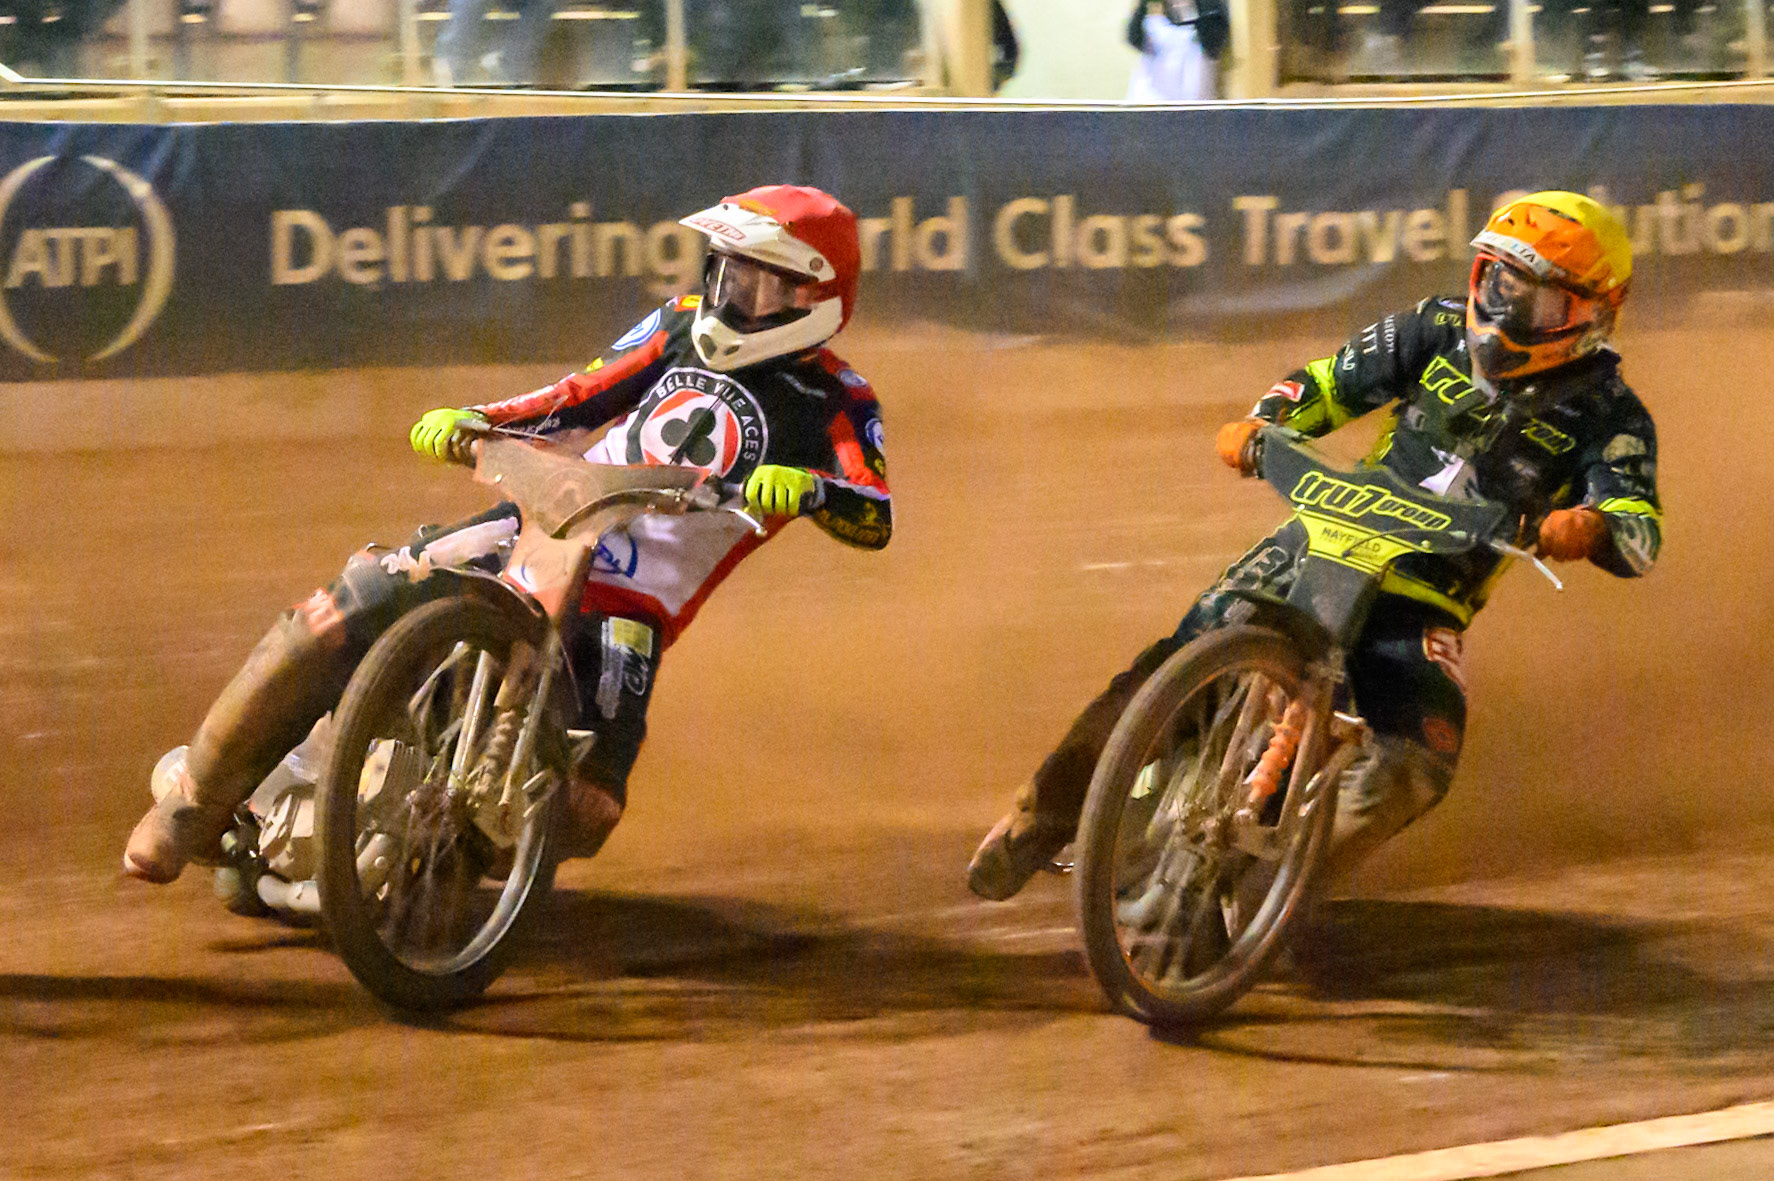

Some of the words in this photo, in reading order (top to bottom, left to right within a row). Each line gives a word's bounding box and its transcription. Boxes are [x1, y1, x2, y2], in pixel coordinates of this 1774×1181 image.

[4, 227, 137, 288] ATPI
[271, 203, 699, 297] Delivering
[859, 197, 967, 270] rld
[995, 196, 1208, 270] Class
[1234, 188, 1470, 265] Travel
[655, 375, 707, 399] BELLE
[741, 415, 759, 462] ACES
